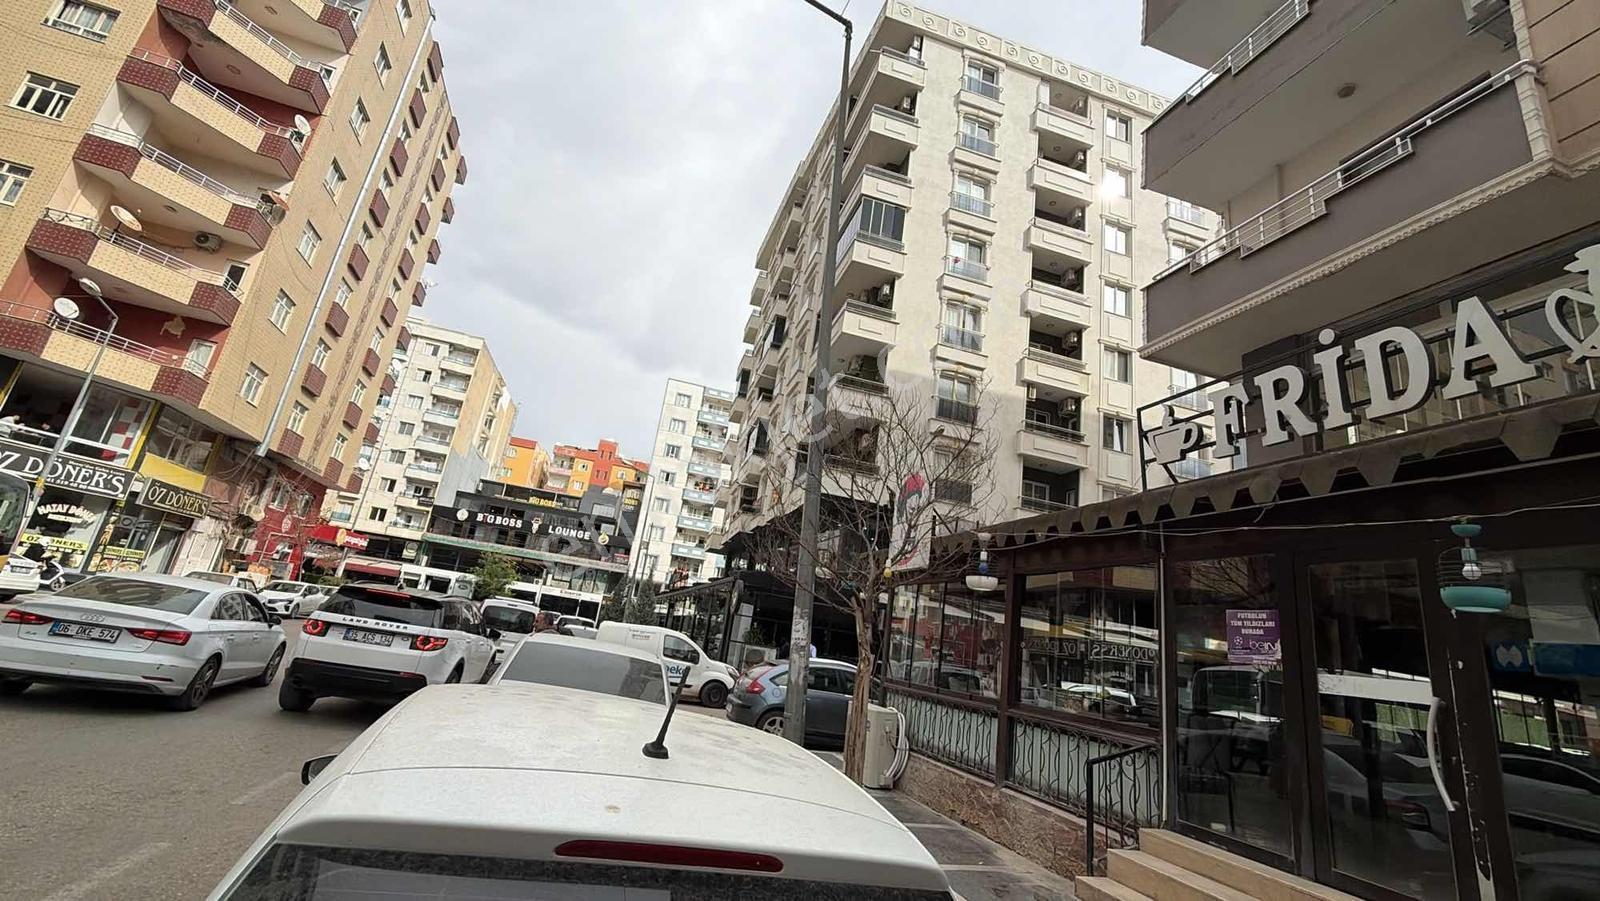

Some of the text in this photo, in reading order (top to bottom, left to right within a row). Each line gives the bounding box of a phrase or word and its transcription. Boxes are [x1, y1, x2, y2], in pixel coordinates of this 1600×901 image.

[548, 525, 591, 540] LOUNGE
[59, 622, 70, 633] 06
[98, 629, 116, 639] 574
[374, 622, 408, 630] ROVER
